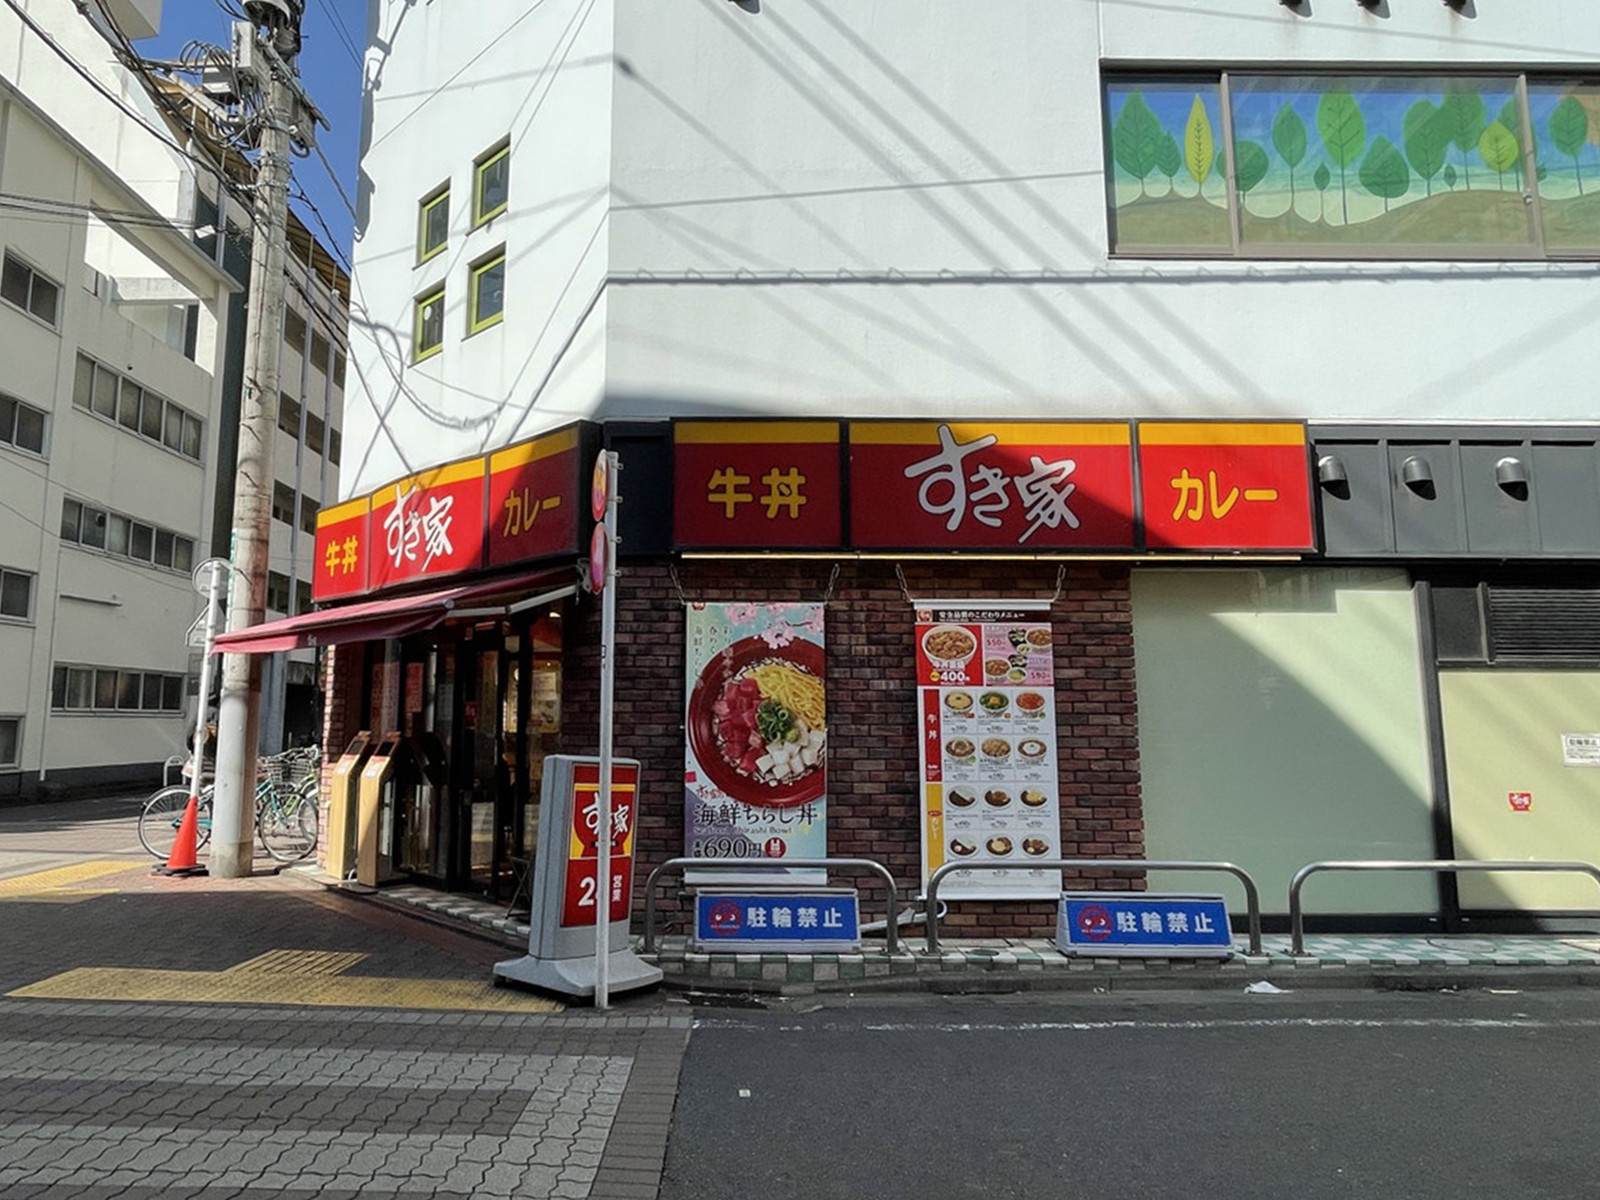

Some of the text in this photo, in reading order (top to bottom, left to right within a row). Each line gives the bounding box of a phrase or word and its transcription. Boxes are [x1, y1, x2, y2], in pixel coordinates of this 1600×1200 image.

[707, 467, 807, 520] 牛丼
[904, 424, 1081, 544] すき家
[1170, 468, 1279, 522] カレー
[383, 483, 454, 573] すき家
[503, 487, 561, 538] カレー
[325, 534, 359, 578] 牛丼
[693, 801, 818, 825] 海鮮ちらし丼
[747, 907, 843, 928] 駐輪禁止
[1116, 911, 1215, 933] 駐輪禁止
